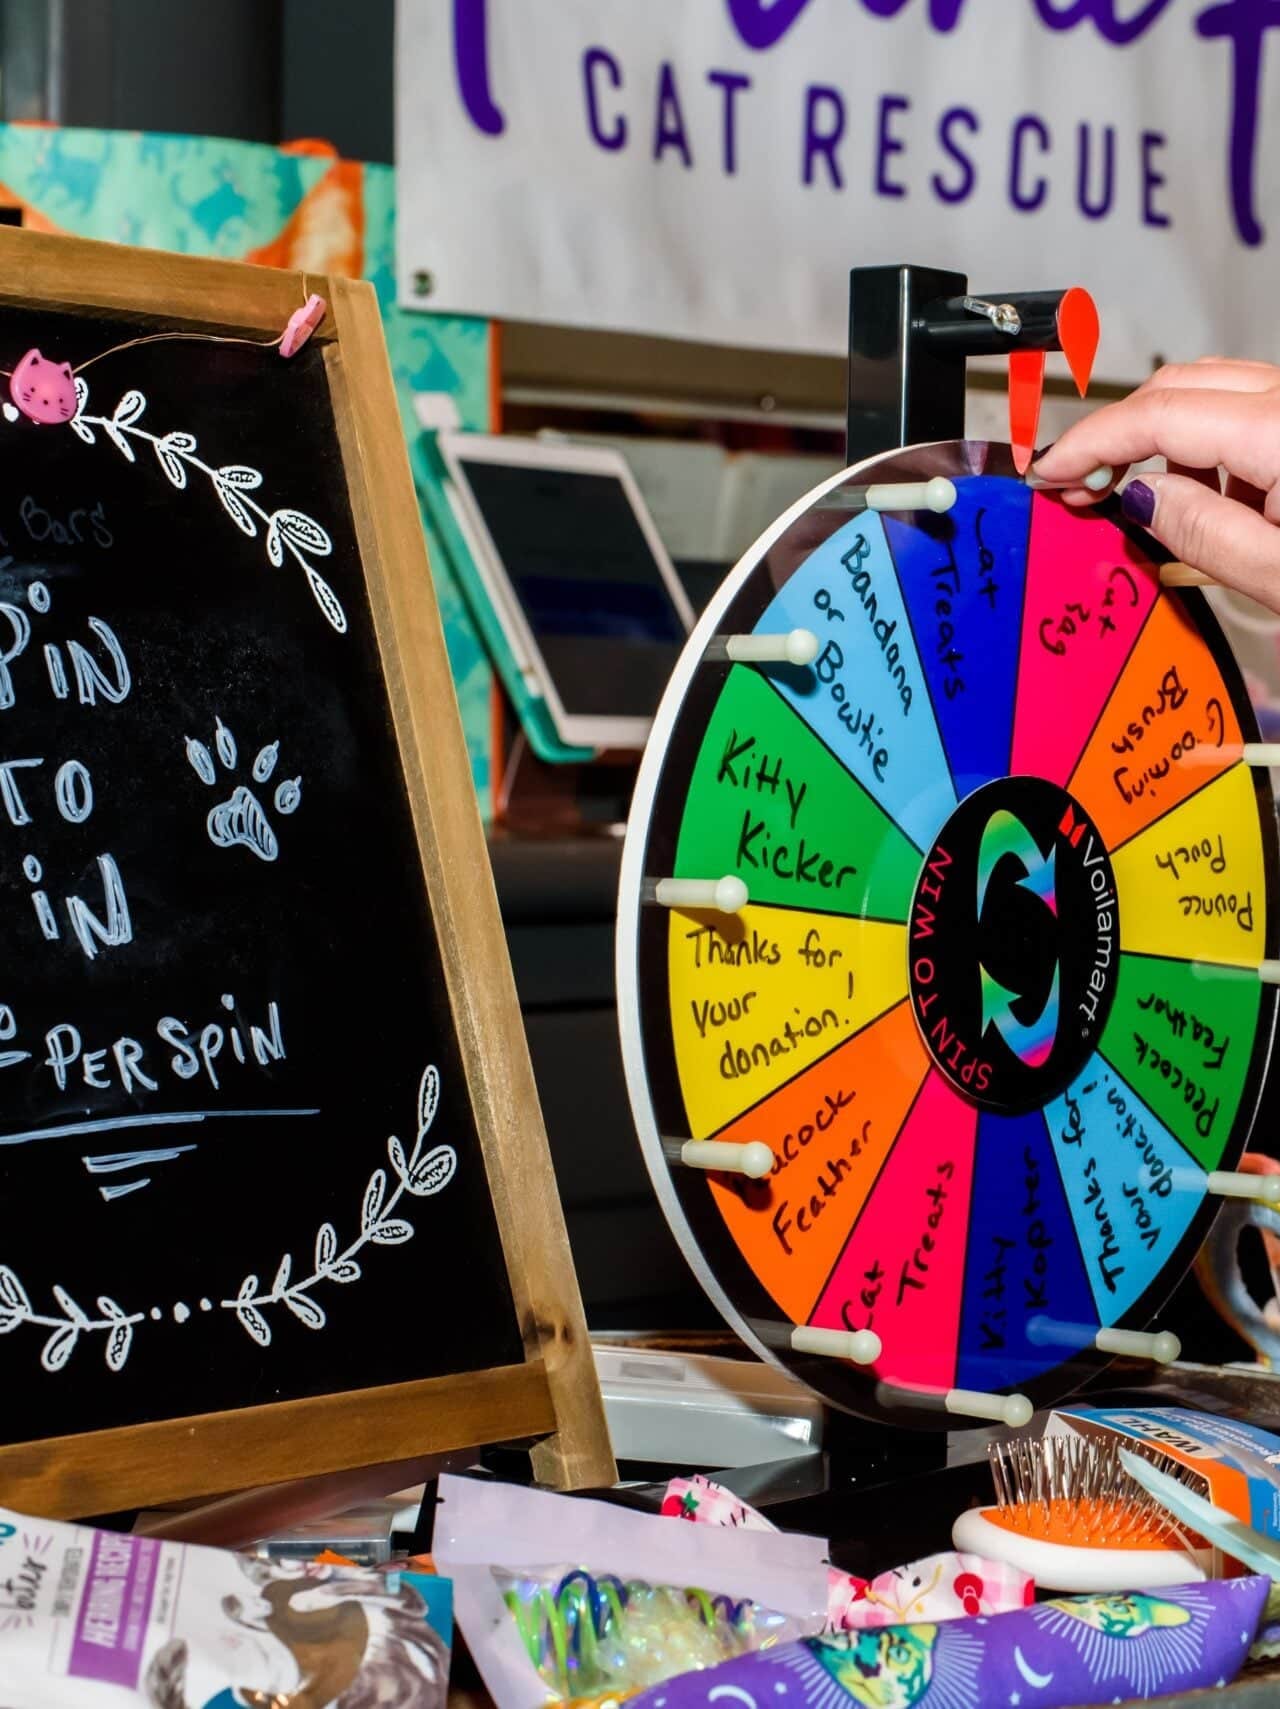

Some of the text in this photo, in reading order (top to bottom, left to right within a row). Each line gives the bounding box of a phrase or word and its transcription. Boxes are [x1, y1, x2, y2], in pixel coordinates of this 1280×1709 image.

[582, 46, 753, 177] CAT
[800, 83, 1174, 231] RESCUE
[813, 588, 845, 624] or
[841, 533, 913, 716] Bandana
[931, 543, 966, 701] Treats
[815, 639, 889, 783] Bowtie
[1111, 665, 1188, 754] Brush
[1113, 698, 1224, 804] Gooming
[717, 728, 807, 830] Kitty
[737, 809, 857, 888] Kicker
[1155, 835, 1226, 880] Pouch
[686, 925, 842, 968] Thanks for
[1079, 835, 1116, 1021] Voilamart
[1179, 891, 1253, 932] Pounce
[913, 845, 993, 1090] SPIN TO WIN
[45, 1024, 158, 1094] PER
[1137, 992, 1230, 1069] Feather
[770, 1090, 856, 1176] acock
[1133, 1031, 1220, 1138] Peacock
[772, 1120, 871, 1255] Feather
[896, 1161, 955, 1307] Treats
[1062, 1088, 1125, 1294] Thanks for
[841, 1260, 885, 1332] Cat
[980, 1236, 1016, 1349] Kitty
[1125, 1417, 1202, 1453] WAHL
